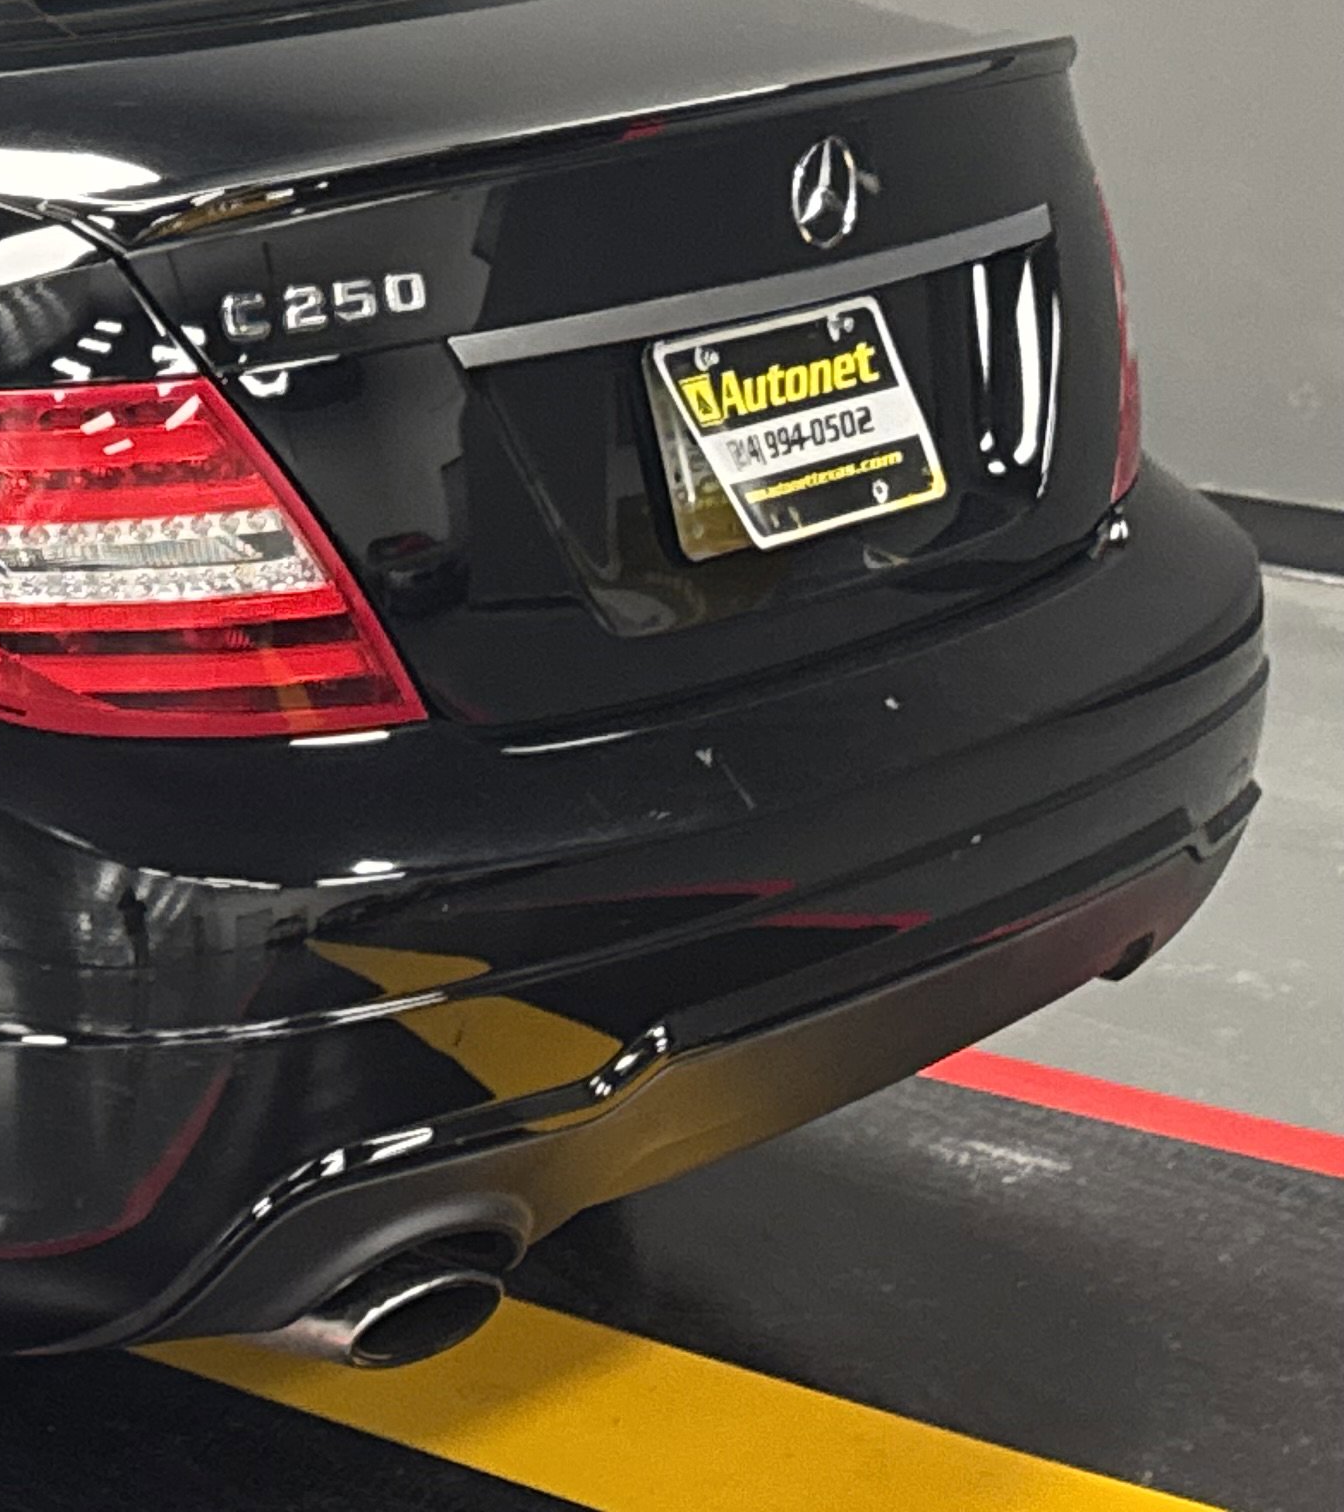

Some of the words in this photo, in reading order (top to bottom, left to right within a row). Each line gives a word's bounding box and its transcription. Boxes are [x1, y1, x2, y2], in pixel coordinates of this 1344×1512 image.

[221, 291, 271, 340] C
[283, 273, 426, 333] 250
[720, 342, 880, 416] Autonet
[764, 405, 876, 459] 994-0502
